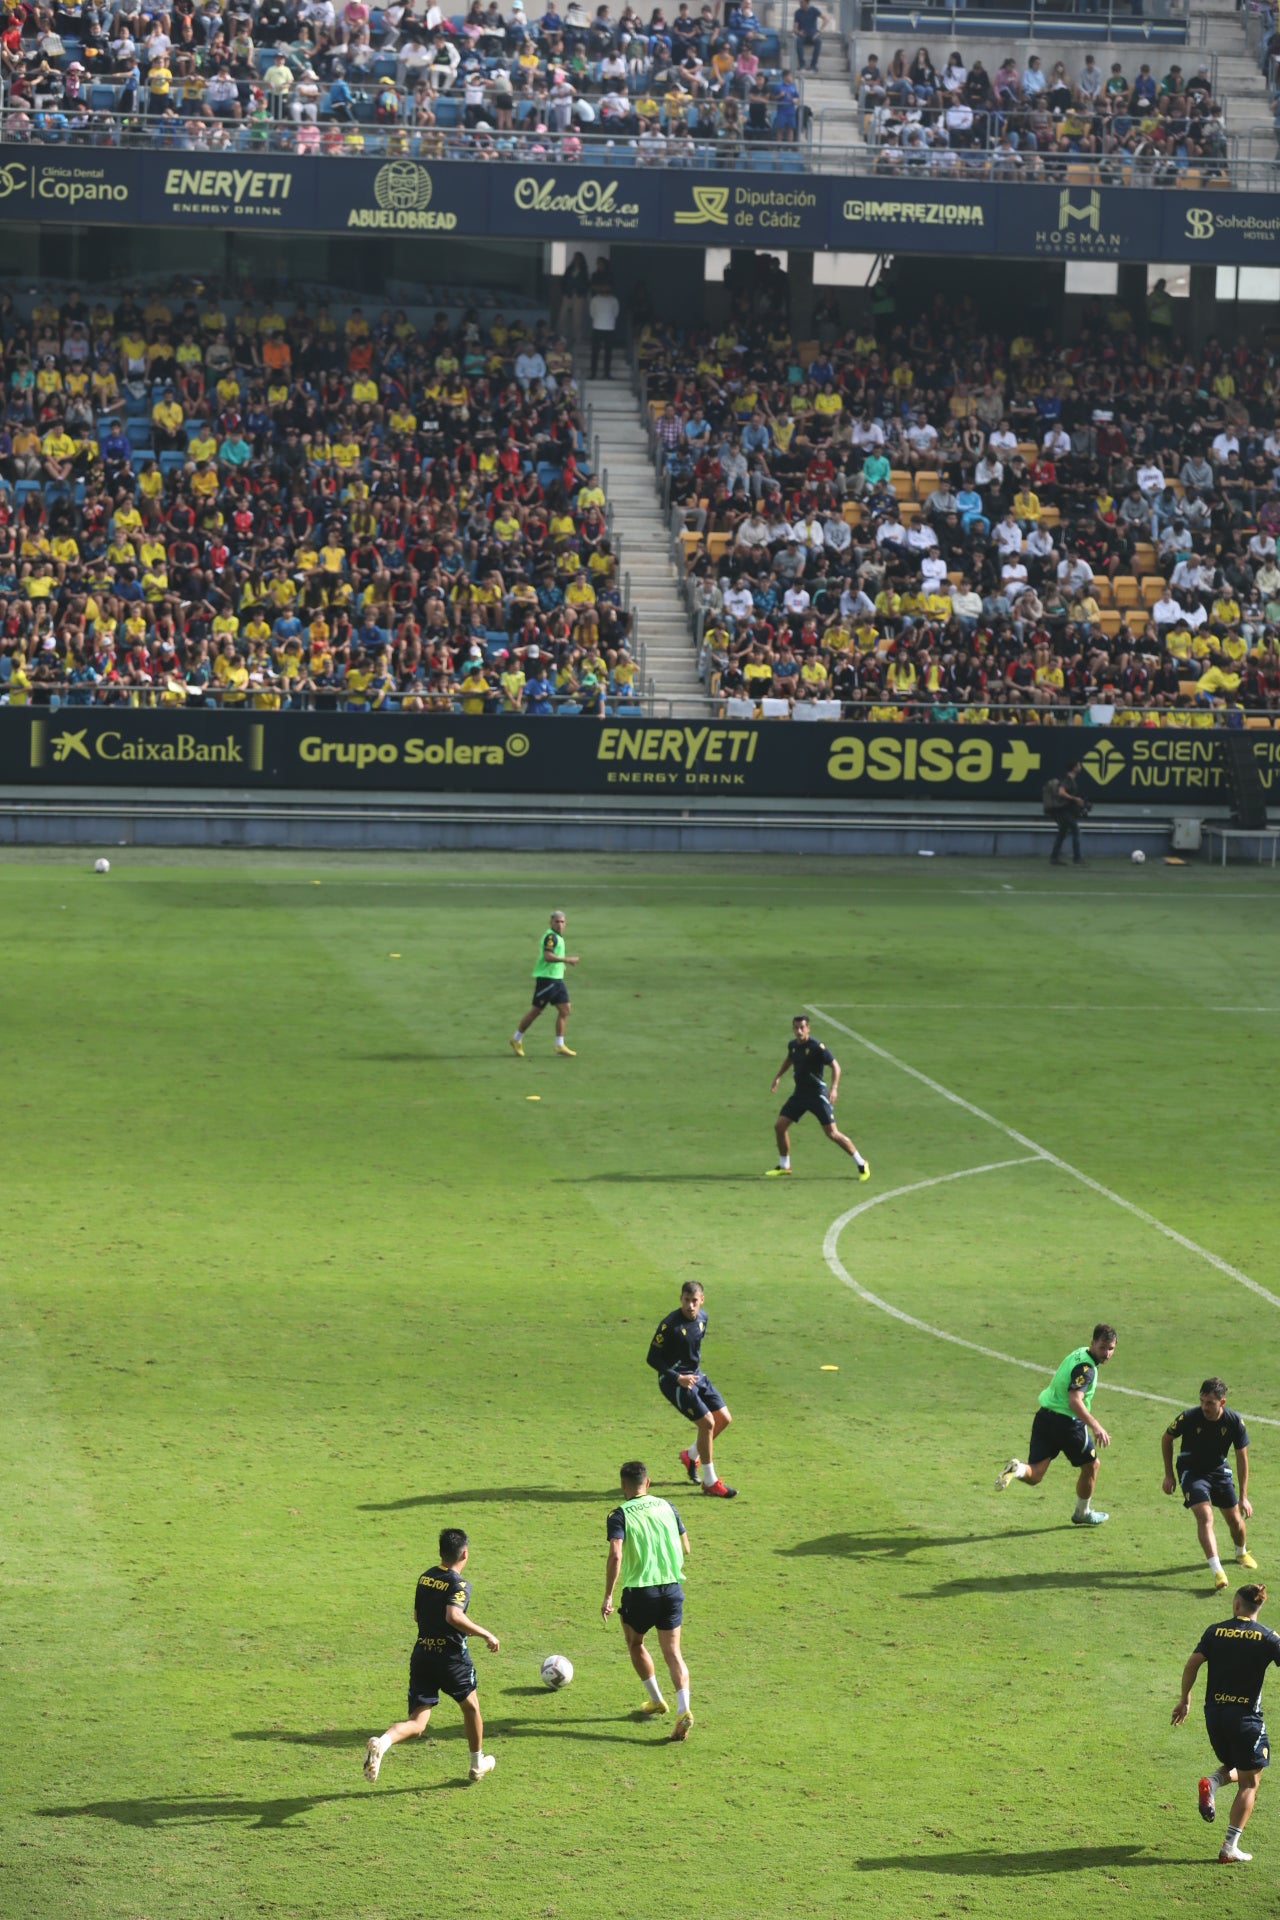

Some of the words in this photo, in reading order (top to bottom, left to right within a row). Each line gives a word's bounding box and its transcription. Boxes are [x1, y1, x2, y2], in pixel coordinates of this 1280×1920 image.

[73, 169, 104, 178] Dental
[38, 178, 128, 205] Copano
[165, 169, 291, 202] ENERYETI
[735, 187, 817, 207] Diputación
[172, 204, 229, 214] ENERGY
[233, 206, 282, 216] DRINK
[347, 209, 458, 230] ABUELOBREAD
[734, 210, 754, 226] de
[758, 210, 801, 228] Cádiz
[864, 201, 983, 224] IMPREZIONA
[1215, 214, 1280, 230] SohoBouti
[1035, 231, 1121, 246] HOSMAN
[95, 731, 243, 763] CaixaBank
[299, 736, 398, 769] Grupo
[404, 738, 504, 765] Solera
[597, 727, 759, 769] ENERYETI
[827, 736, 993, 783] asisa
[607, 772, 679, 783] ENERGY
[685, 773, 745, 784] DRINK
[1215, 1627, 1262, 1641] macron
